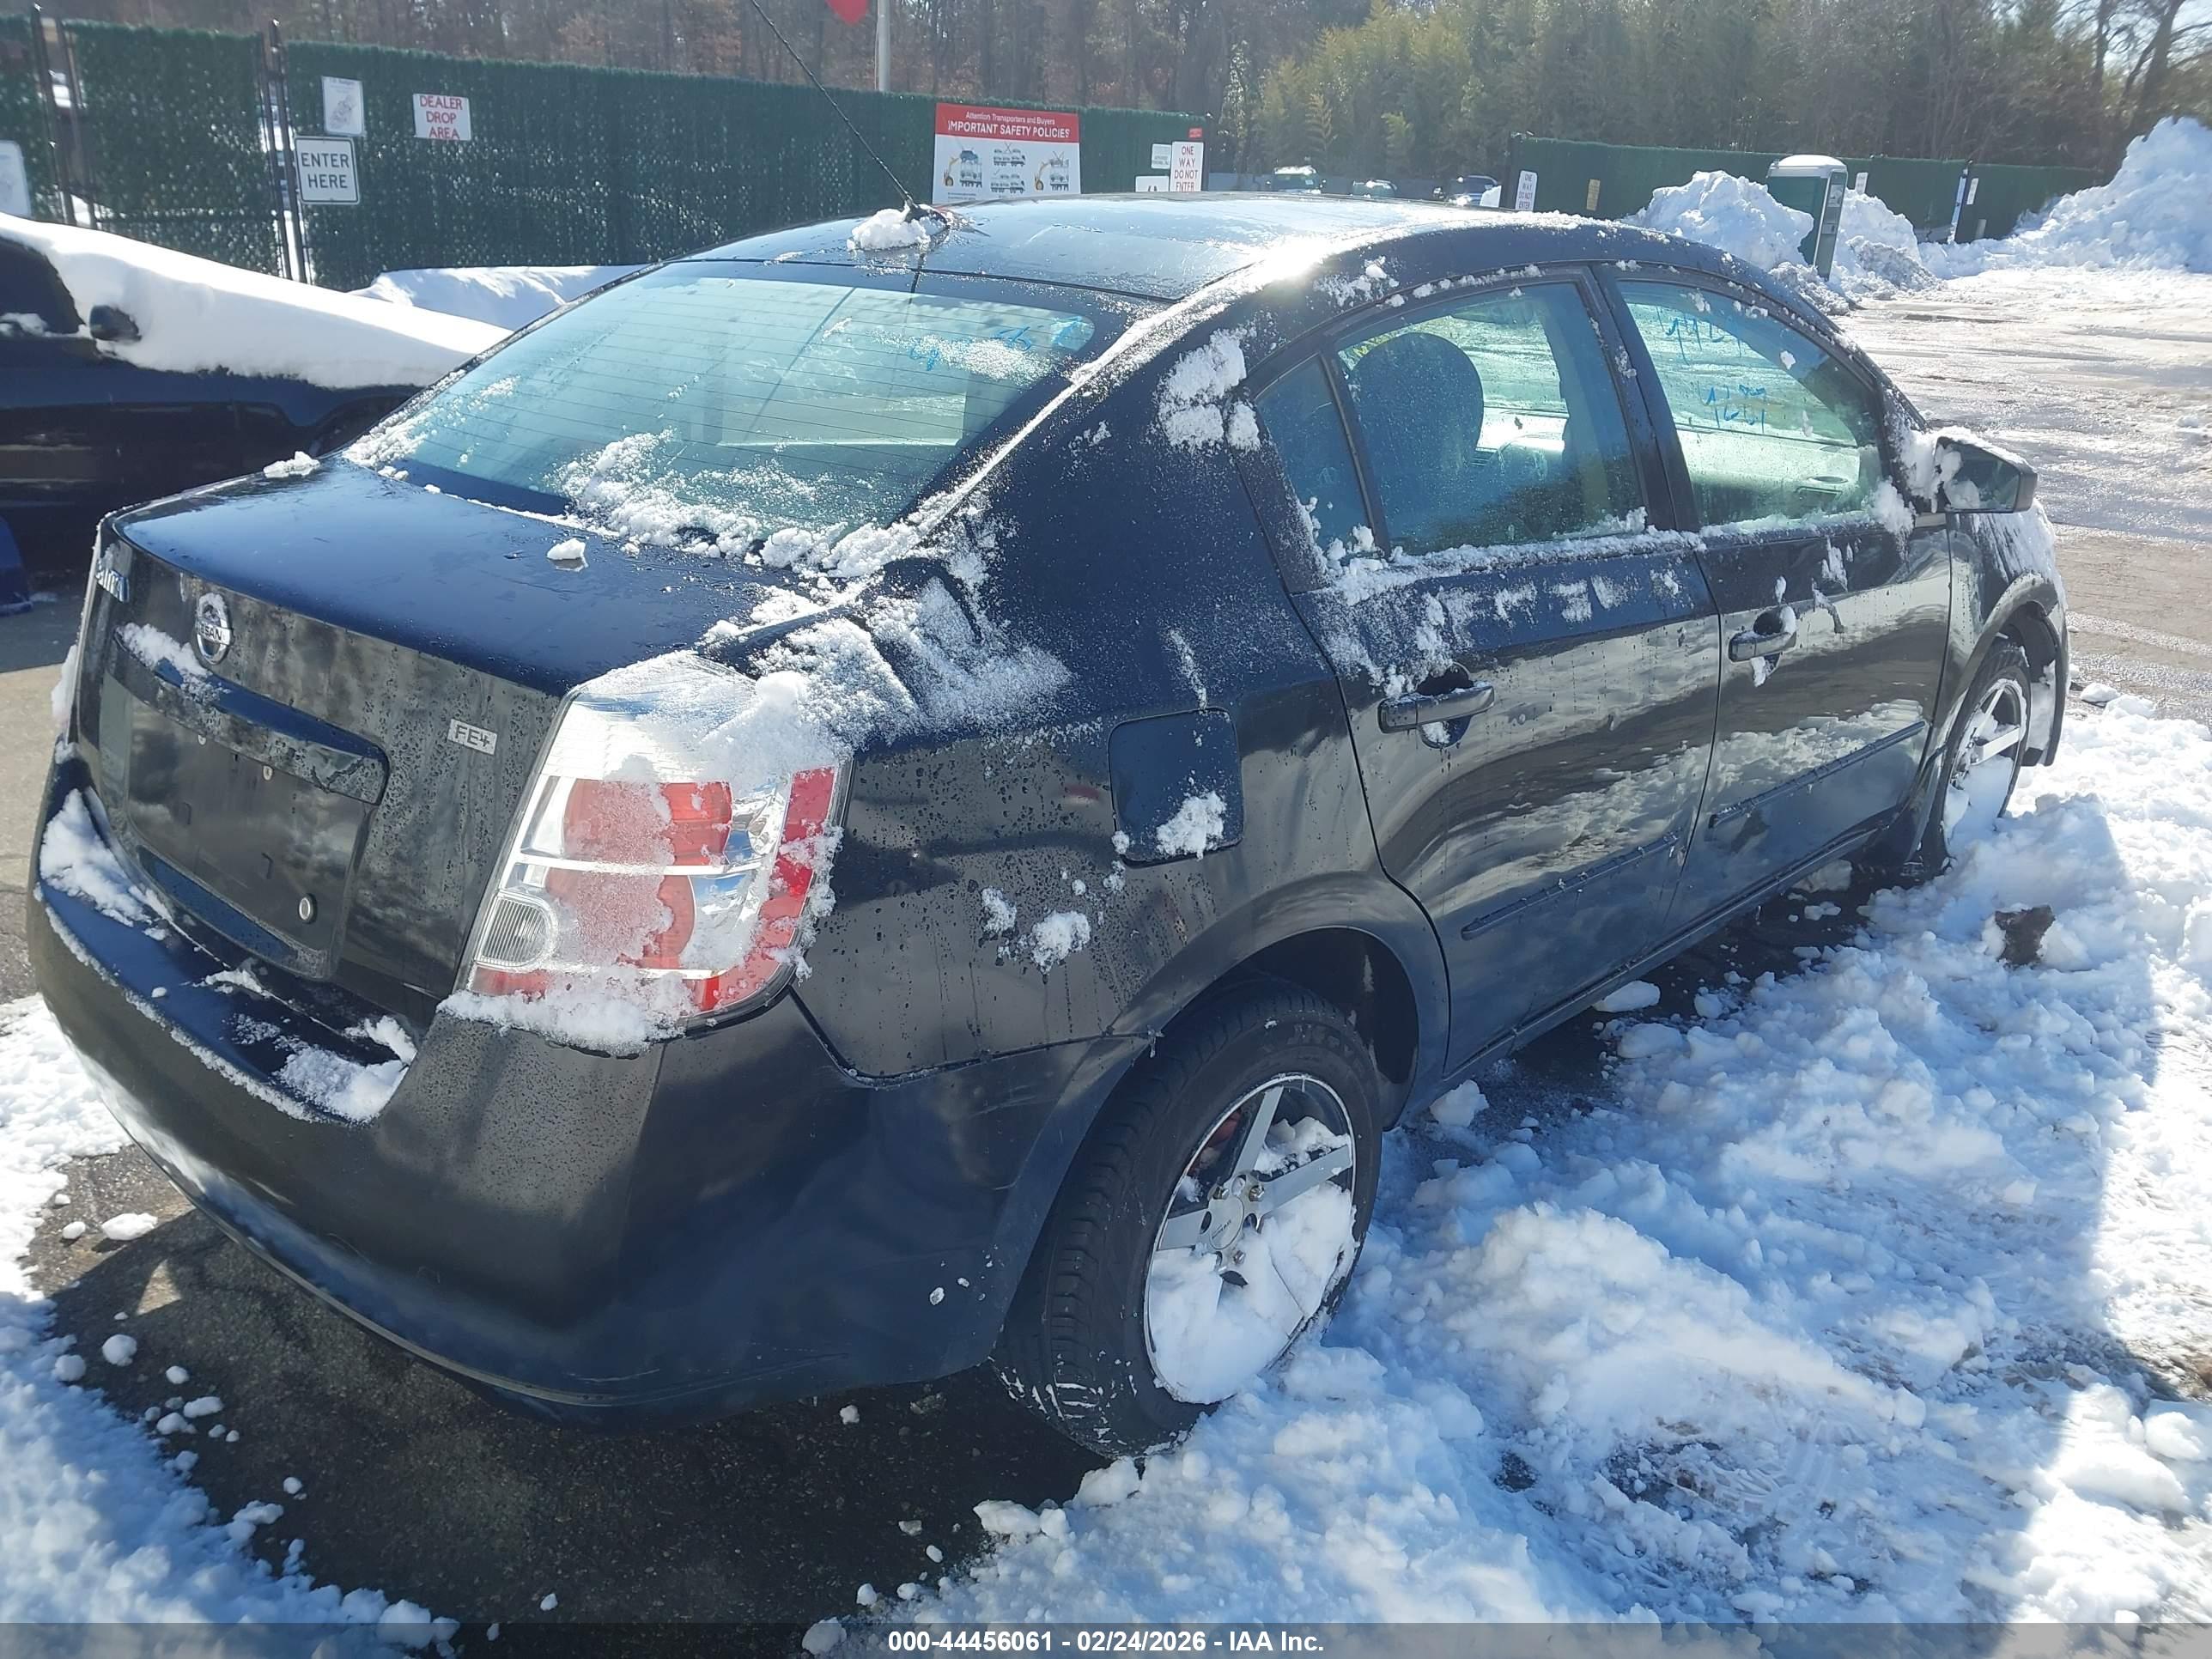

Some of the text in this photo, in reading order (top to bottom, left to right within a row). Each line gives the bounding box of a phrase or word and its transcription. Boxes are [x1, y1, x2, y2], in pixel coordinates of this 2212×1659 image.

[419, 94, 463, 110] DEALER
[426, 110, 457, 125] DROP
[965, 112, 991, 121] Attention
[992, 112, 1026, 124] Transporters
[1036, 117, 1055, 125] Buyers
[428, 125, 461, 140] AREA
[947, 120, 1070, 138] IMPORTANT SAFETY POLICIES
[1181, 145, 1194, 155] ONE
[301, 152, 349, 168] ENTER
[1179, 157, 1196, 167] WAY
[307, 173, 348, 189] HERE
[1174, 170, 1199, 179] DO NOT
